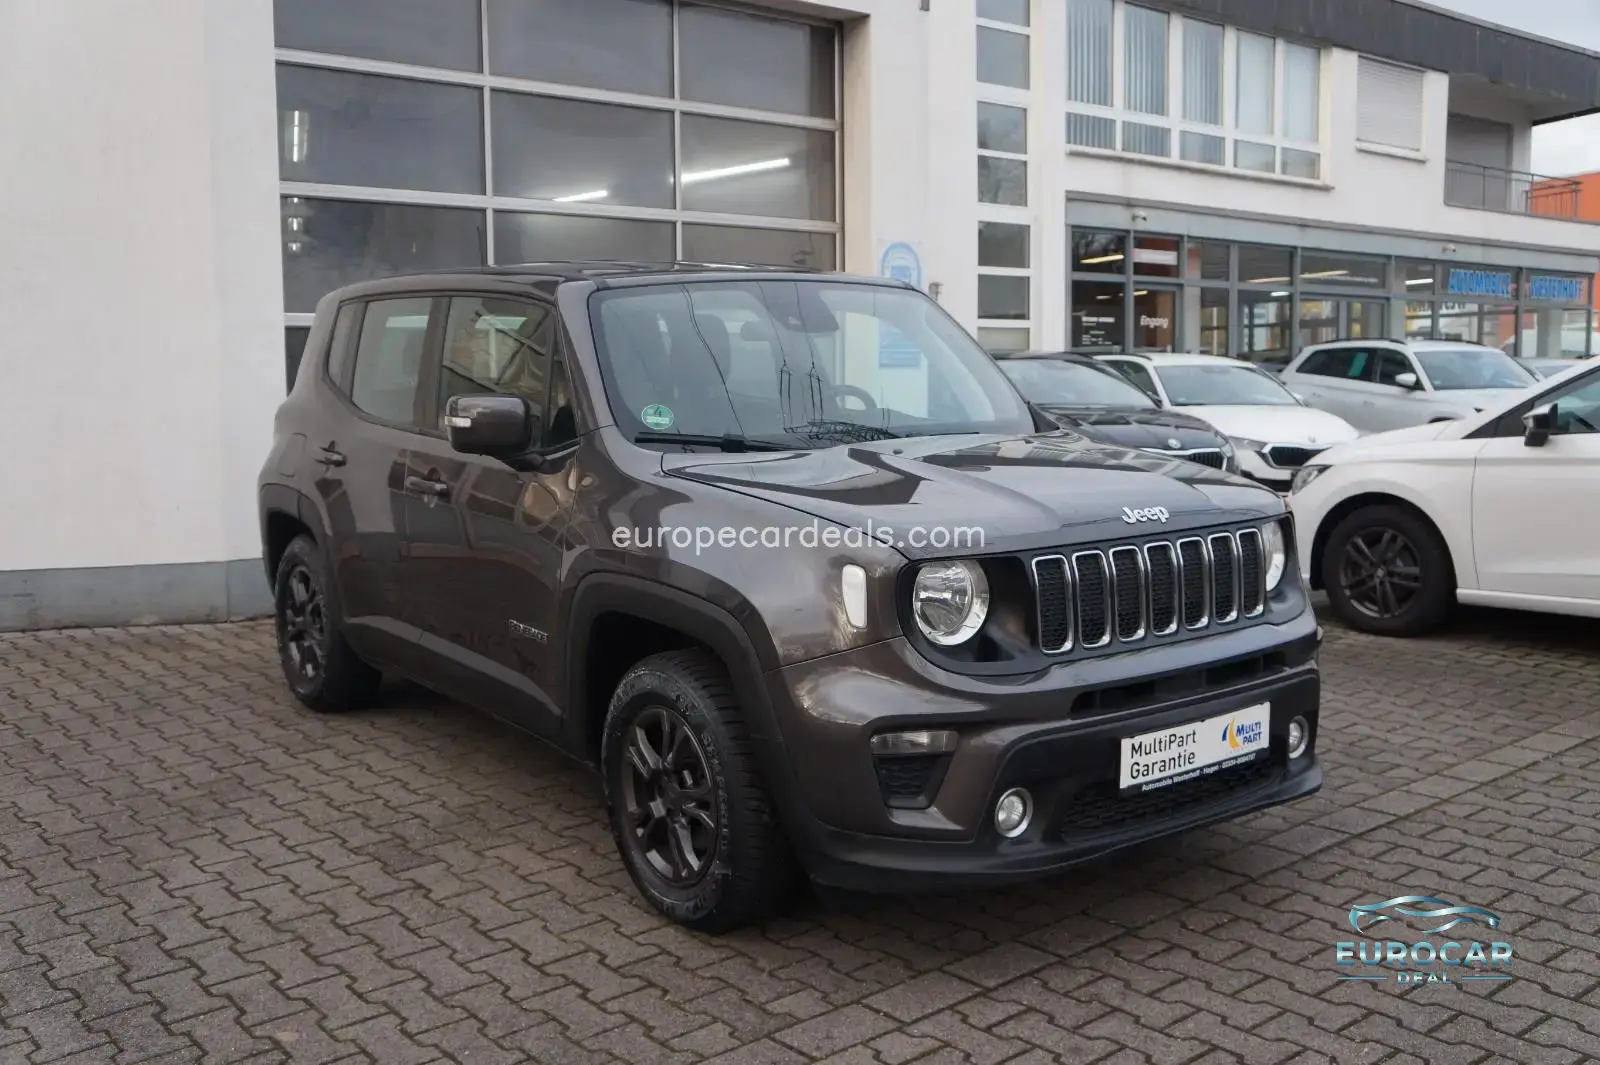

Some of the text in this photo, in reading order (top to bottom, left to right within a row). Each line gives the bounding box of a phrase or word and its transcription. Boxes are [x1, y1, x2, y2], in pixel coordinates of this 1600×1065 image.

[1140, 315, 1169, 329] Eingang
[1122, 507, 1169, 523] Jeep
[1236, 722, 1262, 737] MULTI
[1131, 729, 1197, 759] MultiPart
[1242, 732, 1262, 745] PART
[1130, 750, 1196, 779] Garantie
[1142, 778, 1173, 792] Automobile
